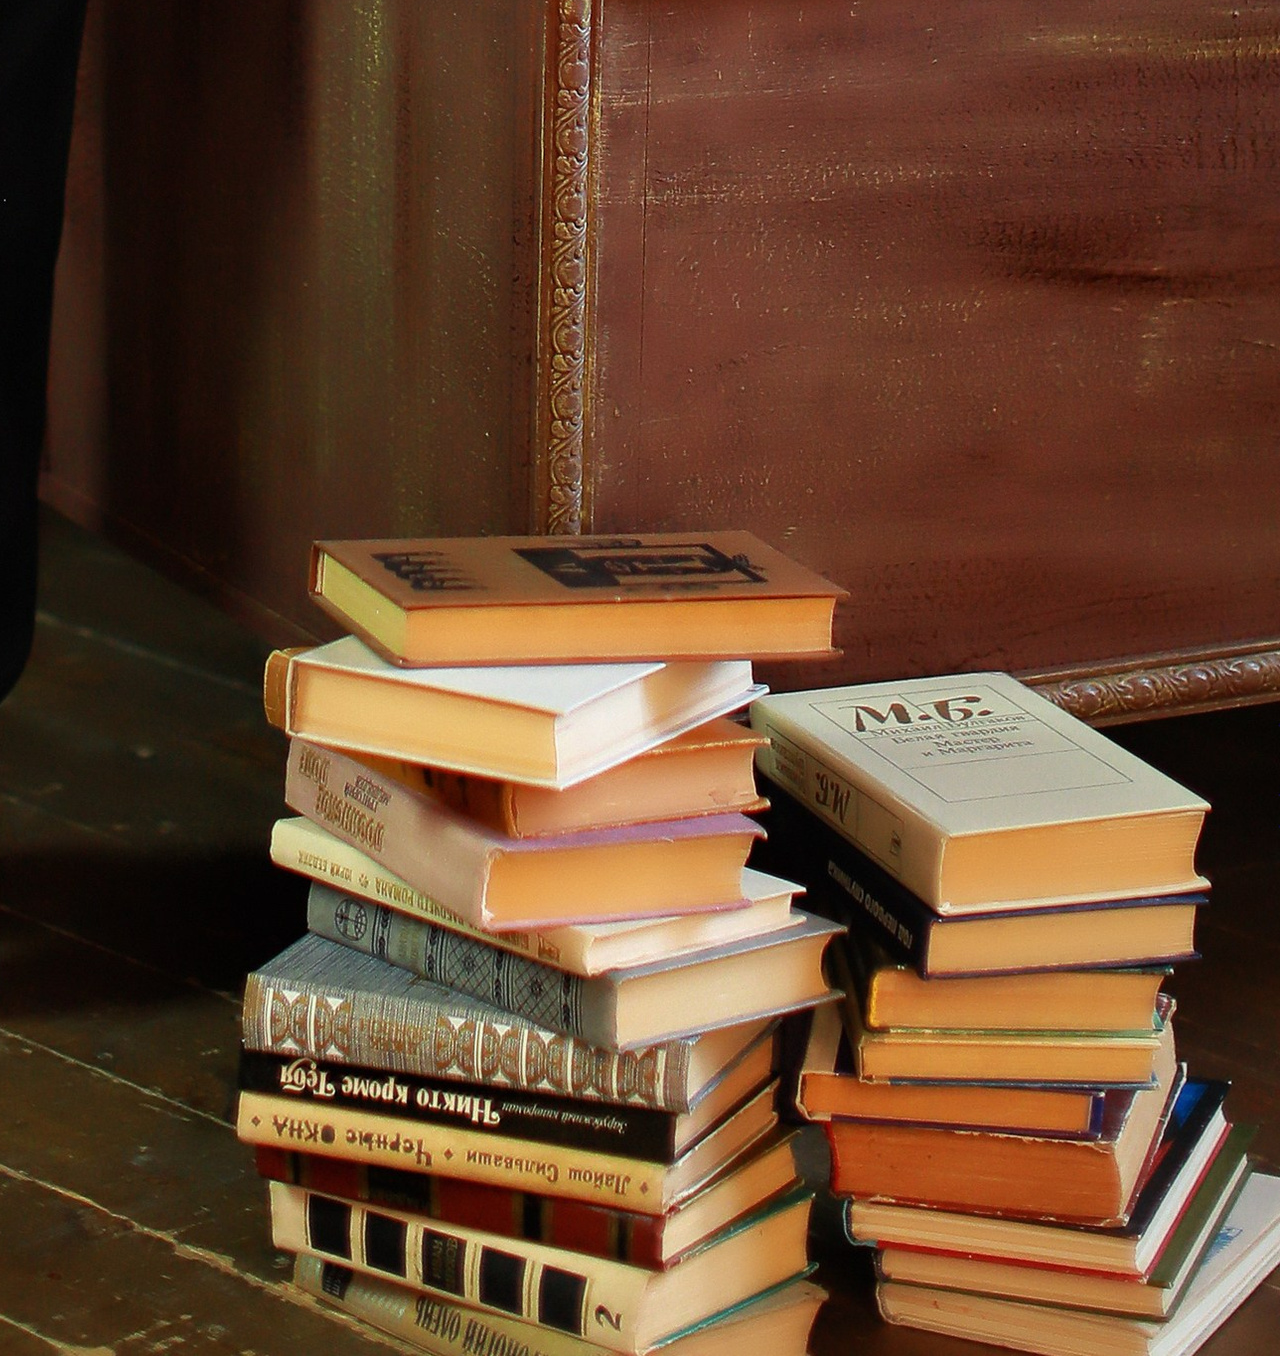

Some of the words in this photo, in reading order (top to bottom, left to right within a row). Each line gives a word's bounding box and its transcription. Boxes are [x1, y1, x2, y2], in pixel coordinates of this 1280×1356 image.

[871, 722, 943, 738] Михаил
[946, 714, 1026, 729] Булгаков
[890, 732, 945, 745] Белая
[951, 724, 1020, 738] гвардия
[921, 750, 933, 758] и
[937, 739, 1035, 756] Маргарита
[934, 736, 1001, 749] Мастер
[329, 862, 353, 882] ЮРИЙ
[374, 876, 415, 908] РОМАНА
[279, 1057, 336, 1098] Тебя
[341, 1075, 409, 1105] кроме
[415, 1086, 501, 1126] Никто
[272, 1114, 336, 1145] ОКНА
[345, 1127, 434, 1168] Черные
[465, 1149, 560, 1184] Сильваши
[569, 1166, 632, 1197] Лайош
[415, 1296, 463, 1343] ОЛЕНЬ
[594, 1303, 623, 1333] 2
